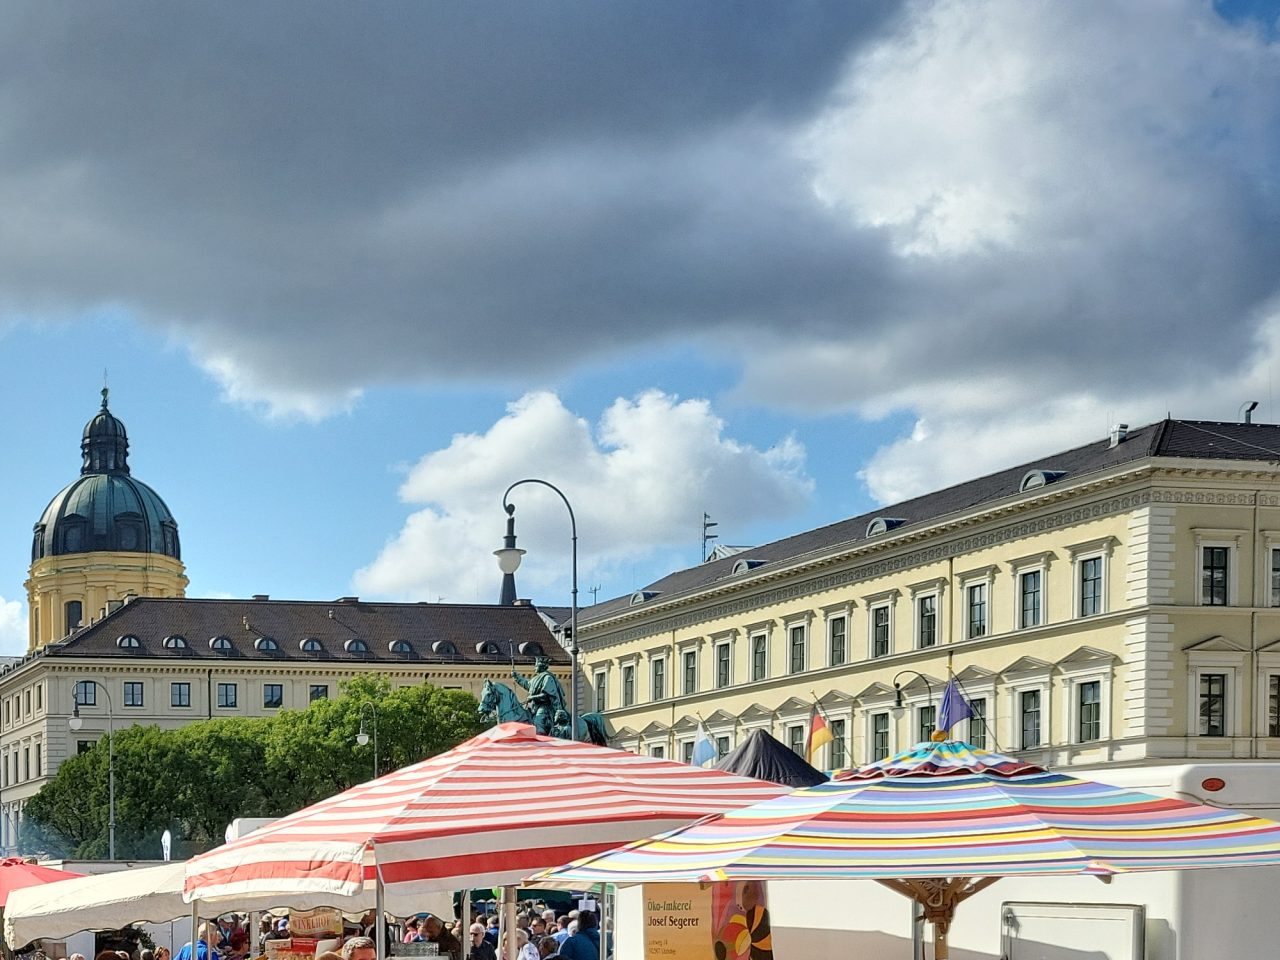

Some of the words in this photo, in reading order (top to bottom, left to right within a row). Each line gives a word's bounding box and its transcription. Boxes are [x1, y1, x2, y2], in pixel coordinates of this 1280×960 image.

[647, 898, 692, 912] Öko-Imkerei
[648, 915, 668, 927] Josef
[668, 915, 699, 929] Segerer
